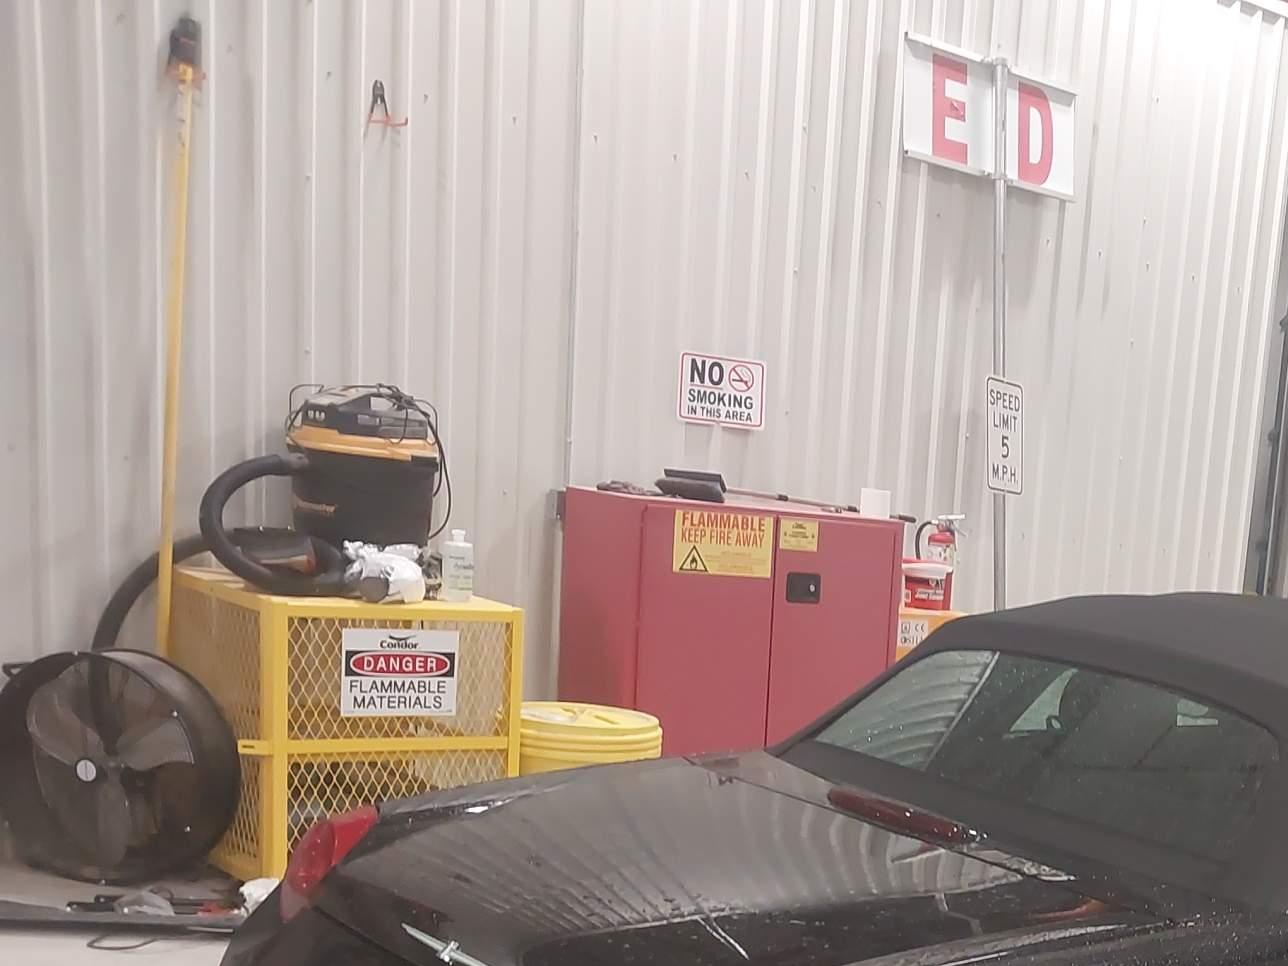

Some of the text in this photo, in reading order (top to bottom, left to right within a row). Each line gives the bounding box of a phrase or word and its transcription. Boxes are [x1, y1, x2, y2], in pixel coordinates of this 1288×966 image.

[932, 53, 967, 165] E
[1018, 81, 1053, 186] D
[689, 358, 724, 386] NO
[688, 388, 754, 410] SMOKING
[989, 388, 1021, 412] SPEED
[687, 405, 753, 423] IN THIS AREA
[993, 411, 1018, 432] LIMIT
[1001, 434, 1010, 459] 5
[682, 512, 766, 532] FLAMMABLE
[681, 528, 707, 544] KEEP
[710, 530, 732, 546] FIRE
[735, 532, 766, 549] AWAY
[380, 640, 419, 650] Condor
[363, 656, 437, 672] DANGER
[349, 680, 447, 694] FLAMMABLE
[353, 695, 443, 709] MATERIALS
